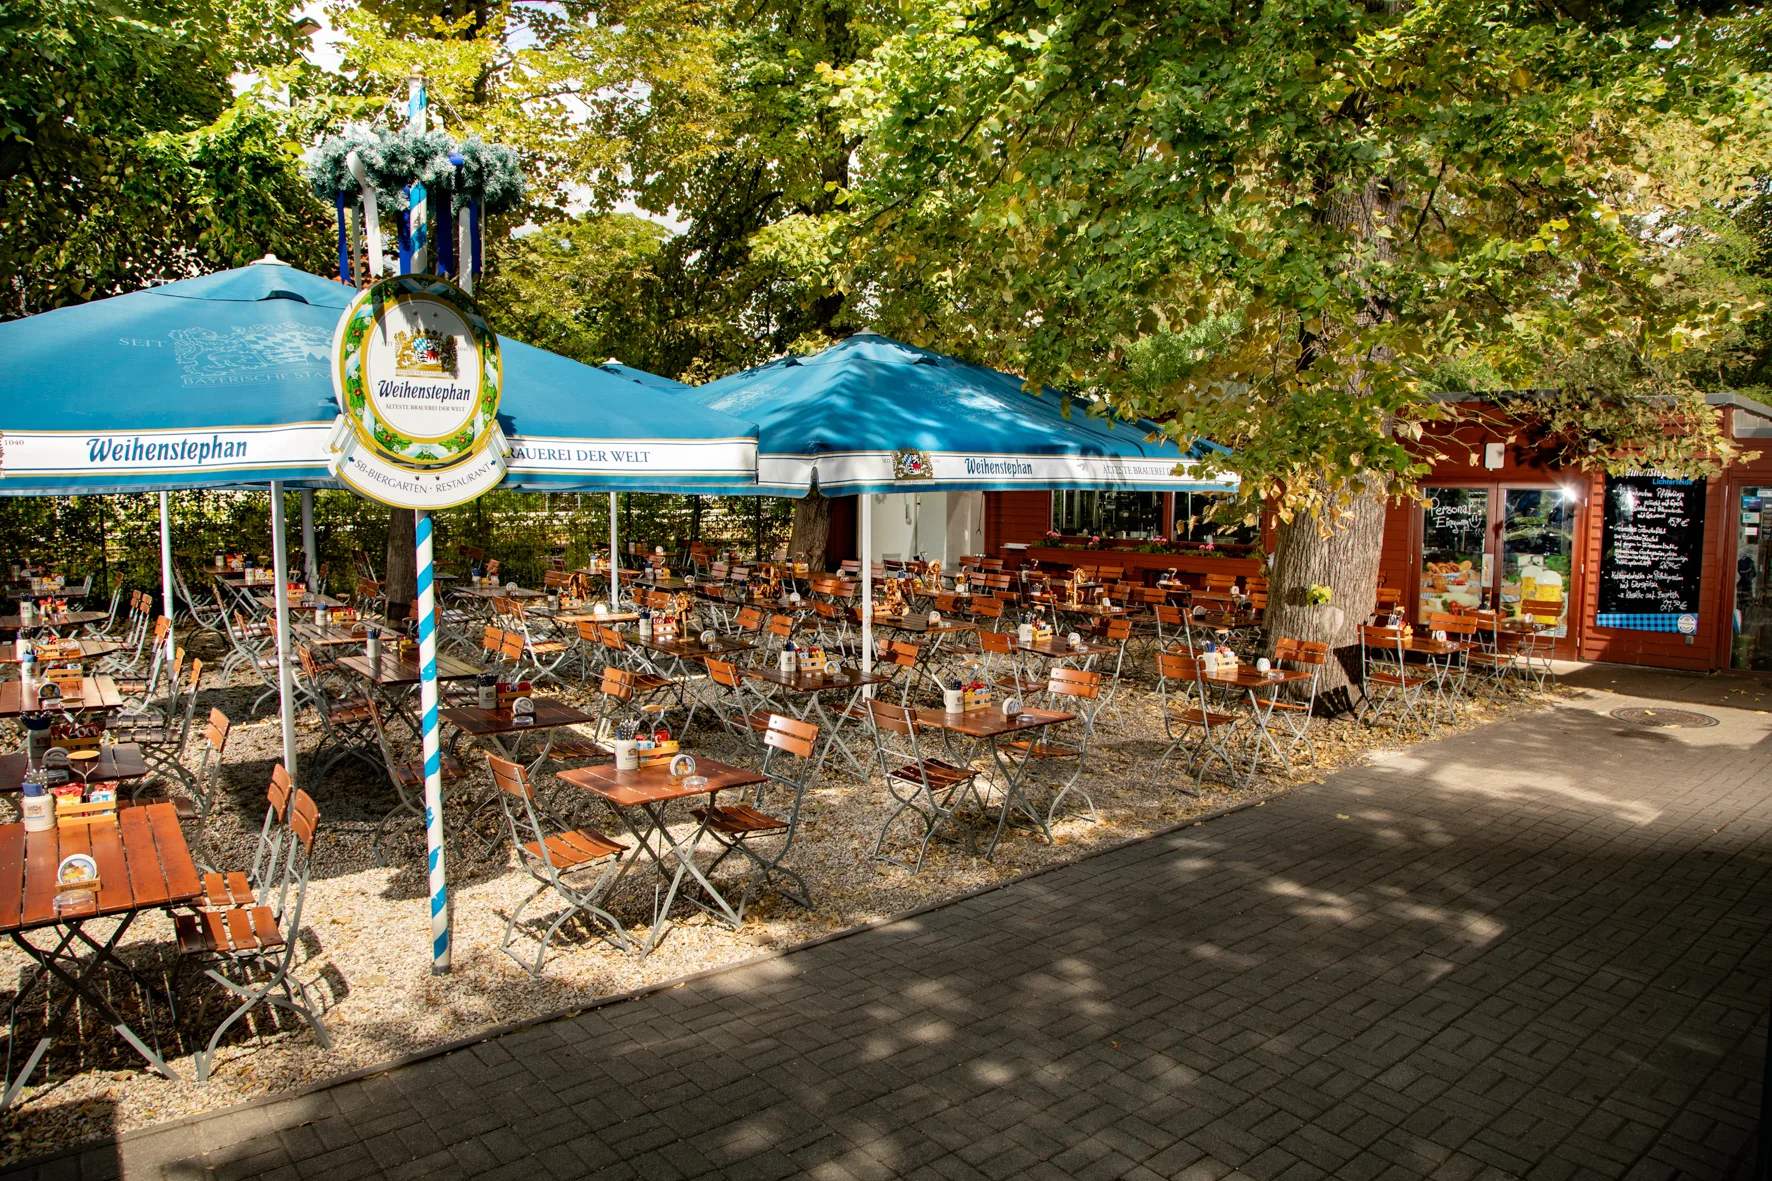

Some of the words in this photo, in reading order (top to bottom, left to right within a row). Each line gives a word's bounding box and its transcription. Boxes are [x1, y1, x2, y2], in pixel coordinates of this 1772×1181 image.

[118, 338, 168, 348] SEIT
[377, 380, 471, 403] Weihenstephan
[410, 404, 437, 412] BRAUEREI
[86, 435, 248, 463] Weihenstephan
[576, 449, 608, 462] DER
[609, 450, 650, 463] WELT
[964, 457, 1033, 477] Weihenstephan
[1133, 466, 1166, 476] BRAUEREI
[354, 460, 427, 494] SB-BIERGARTEN
[436, 462, 491, 493] RESTAURANT
[1652, 478, 1693, 486] Lichterfelde
[1430, 497, 1474, 517] Personal
